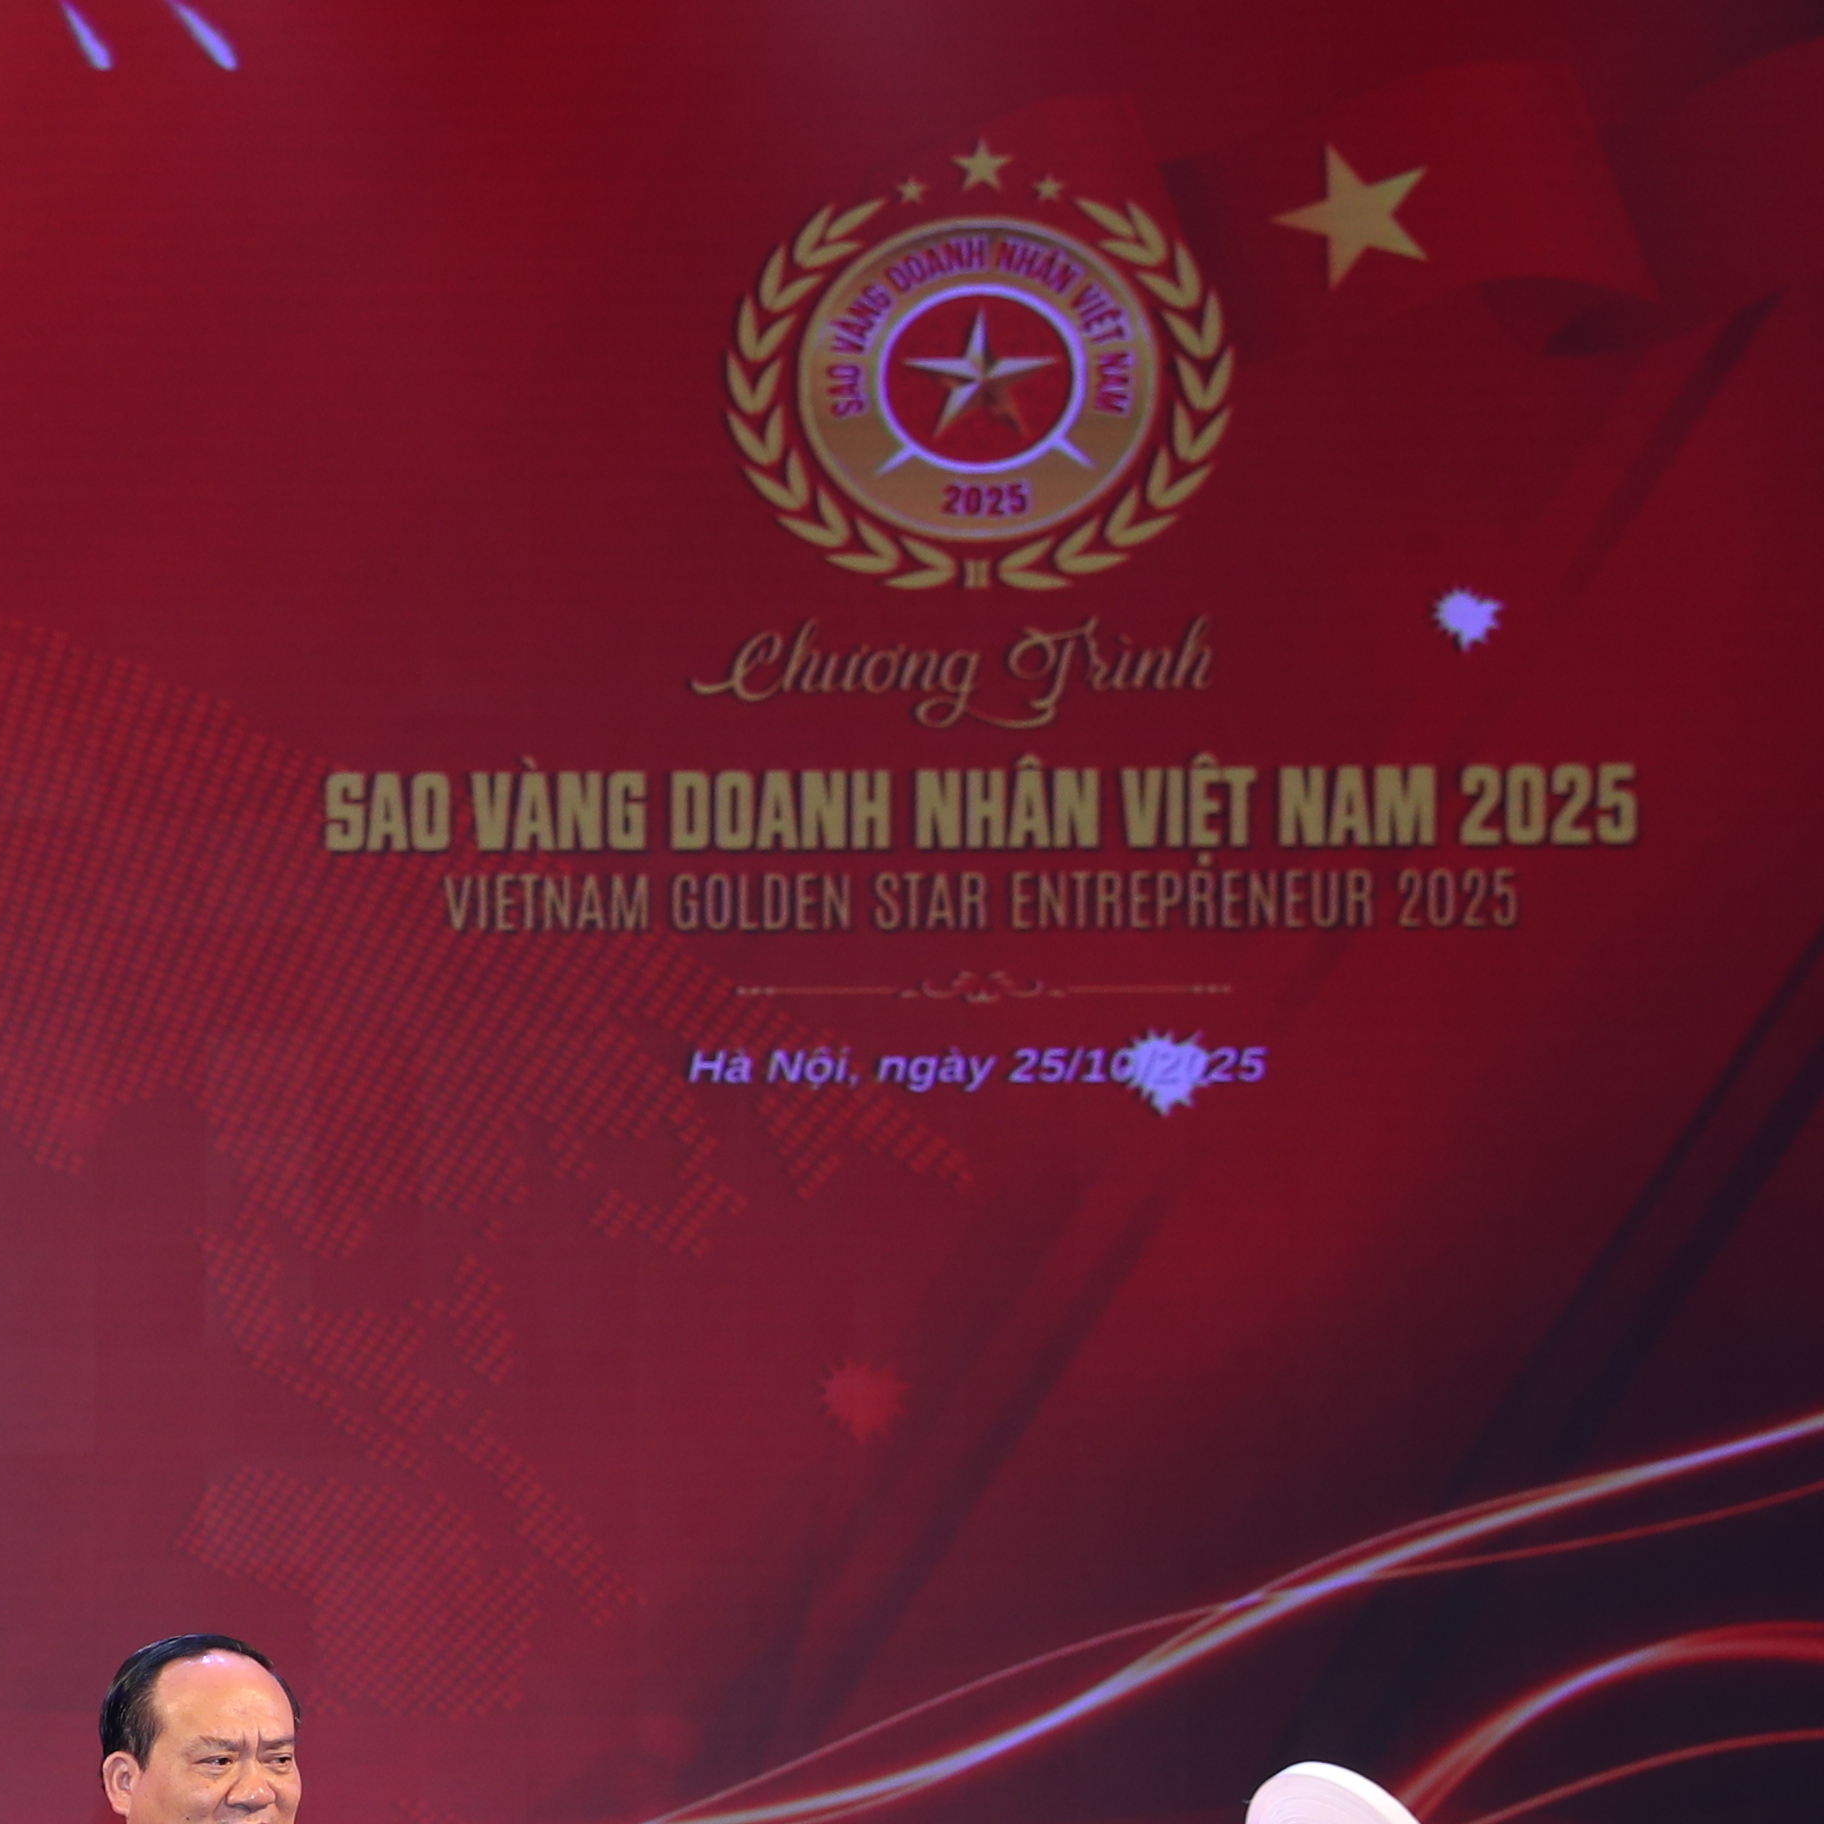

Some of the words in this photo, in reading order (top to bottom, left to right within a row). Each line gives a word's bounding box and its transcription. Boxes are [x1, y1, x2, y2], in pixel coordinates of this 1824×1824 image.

[942, 480, 1030, 517] 2025
[690, 618, 980, 728] Chương
[1007, 616, 1212, 728] Trình
[324, 771, 451, 852] SAO
[470, 756, 647, 852] VÀNG
[670, 769, 891, 850] DOANH
[916, 753, 1099, 849] NHÂN
[1122, 752, 1256, 867] VIỆT
[1280, 766, 1436, 847] NAM
[1459, 762, 1637, 846] 2025
[444, 873, 650, 932] VIETNAM
[670, 872, 851, 931] GOLDEN
[874, 870, 987, 930] STAR
[1011, 869, 1373, 931] ENTREPRENEUR
[1397, 869, 1517, 928] 2025
[689, 1049, 752, 1083] Hà
[767, 1047, 858, 1090] Nội,
[878, 1048, 995, 1092] ngày
